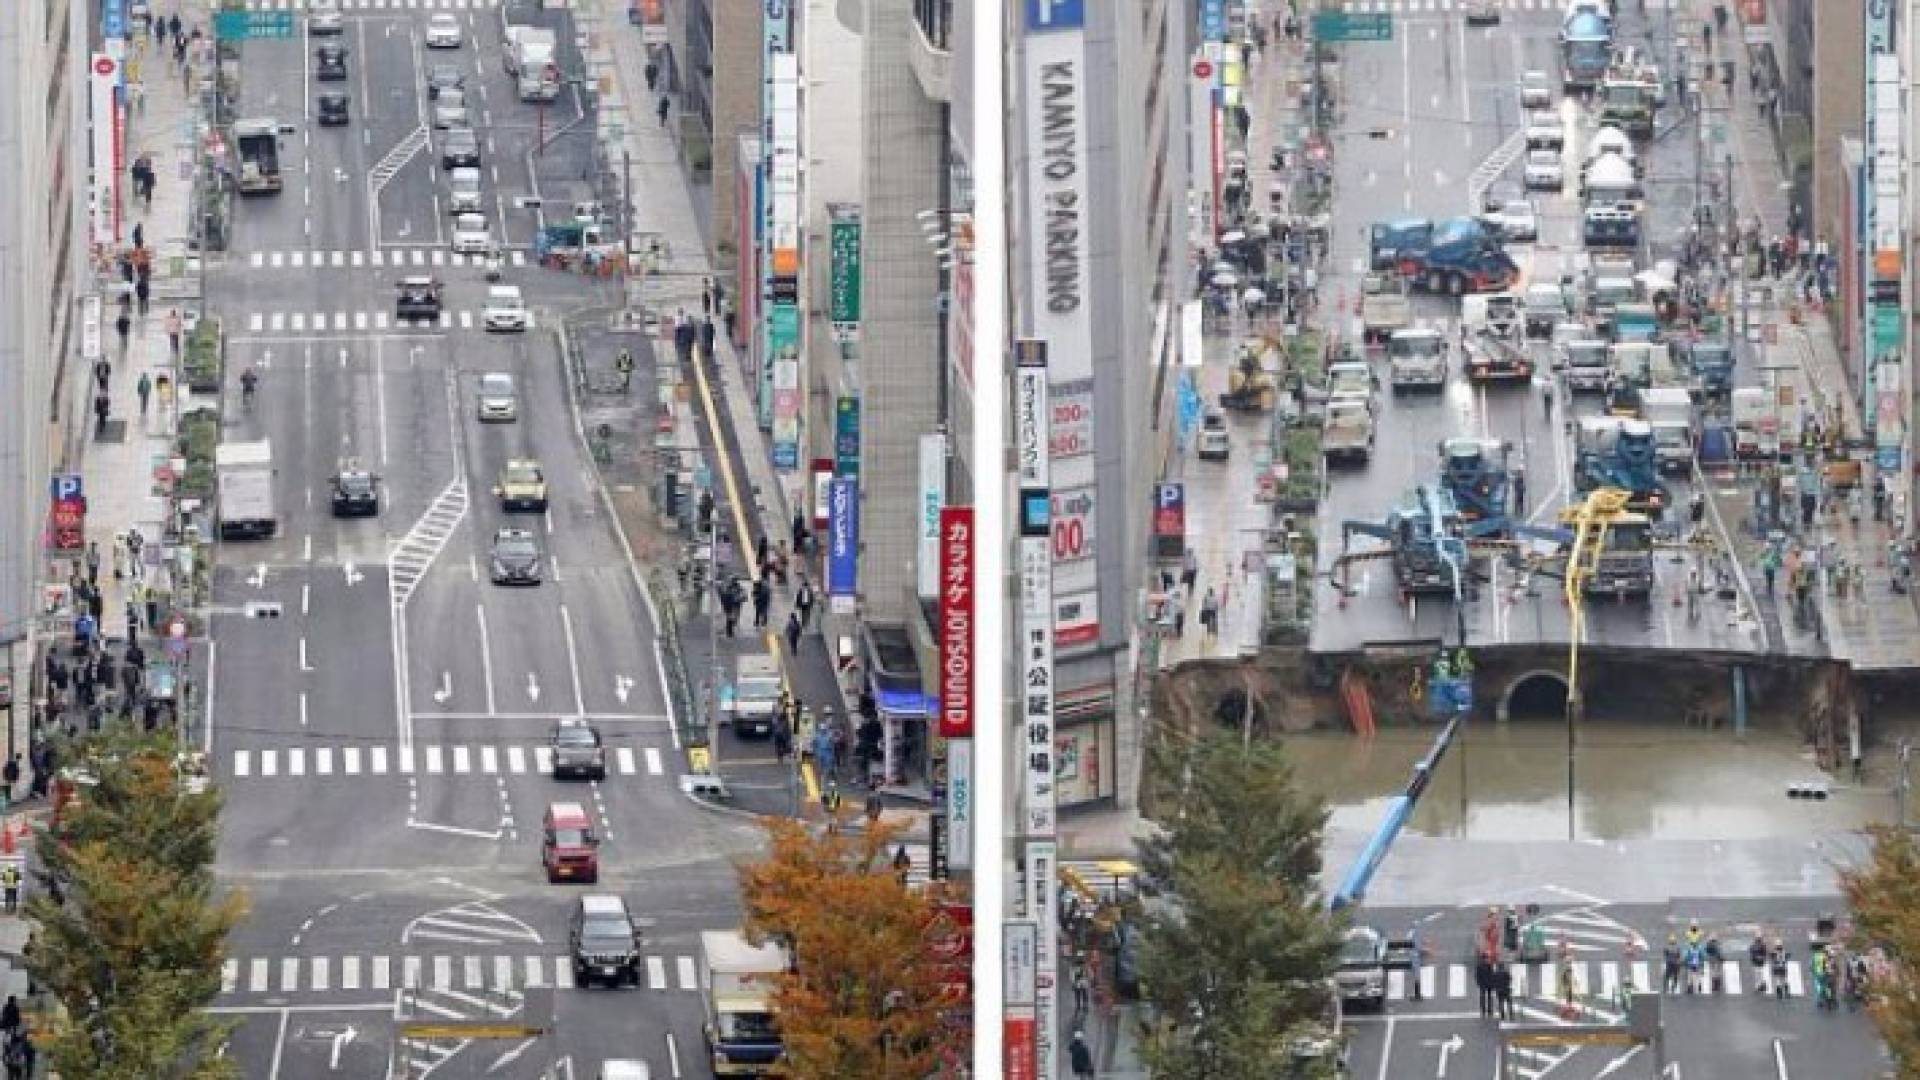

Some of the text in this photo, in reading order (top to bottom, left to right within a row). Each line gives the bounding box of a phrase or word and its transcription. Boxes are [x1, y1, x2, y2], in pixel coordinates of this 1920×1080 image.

[1044, 188, 1080, 314] PARKING
[59, 479, 77, 501] P
[1161, 485, 1178, 508] P
